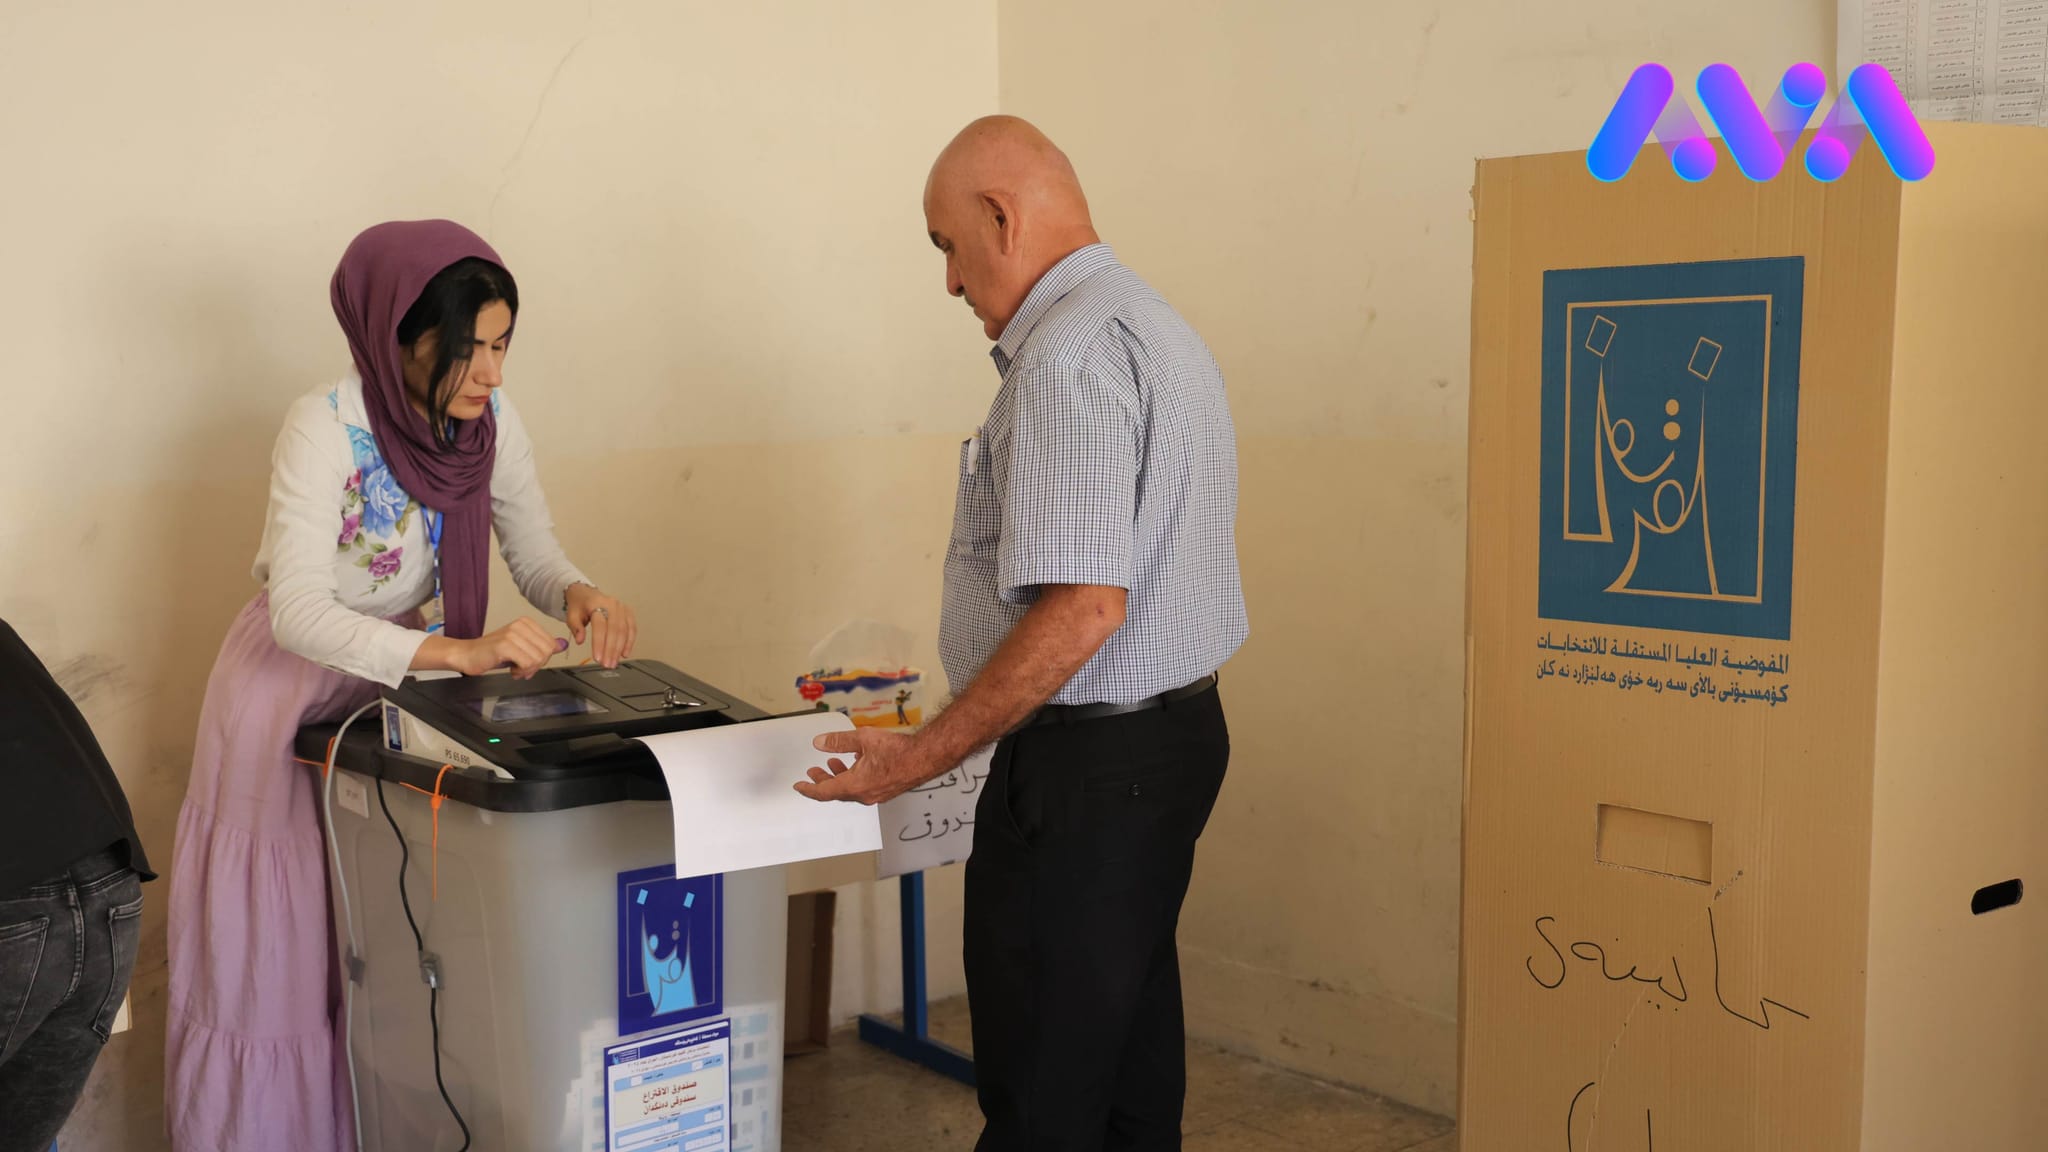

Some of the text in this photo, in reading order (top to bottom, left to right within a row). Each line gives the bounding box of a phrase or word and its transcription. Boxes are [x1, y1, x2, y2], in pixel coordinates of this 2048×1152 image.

[1536, 632, 1789, 678] المفوضية العليا المستقلة للانتخابات
